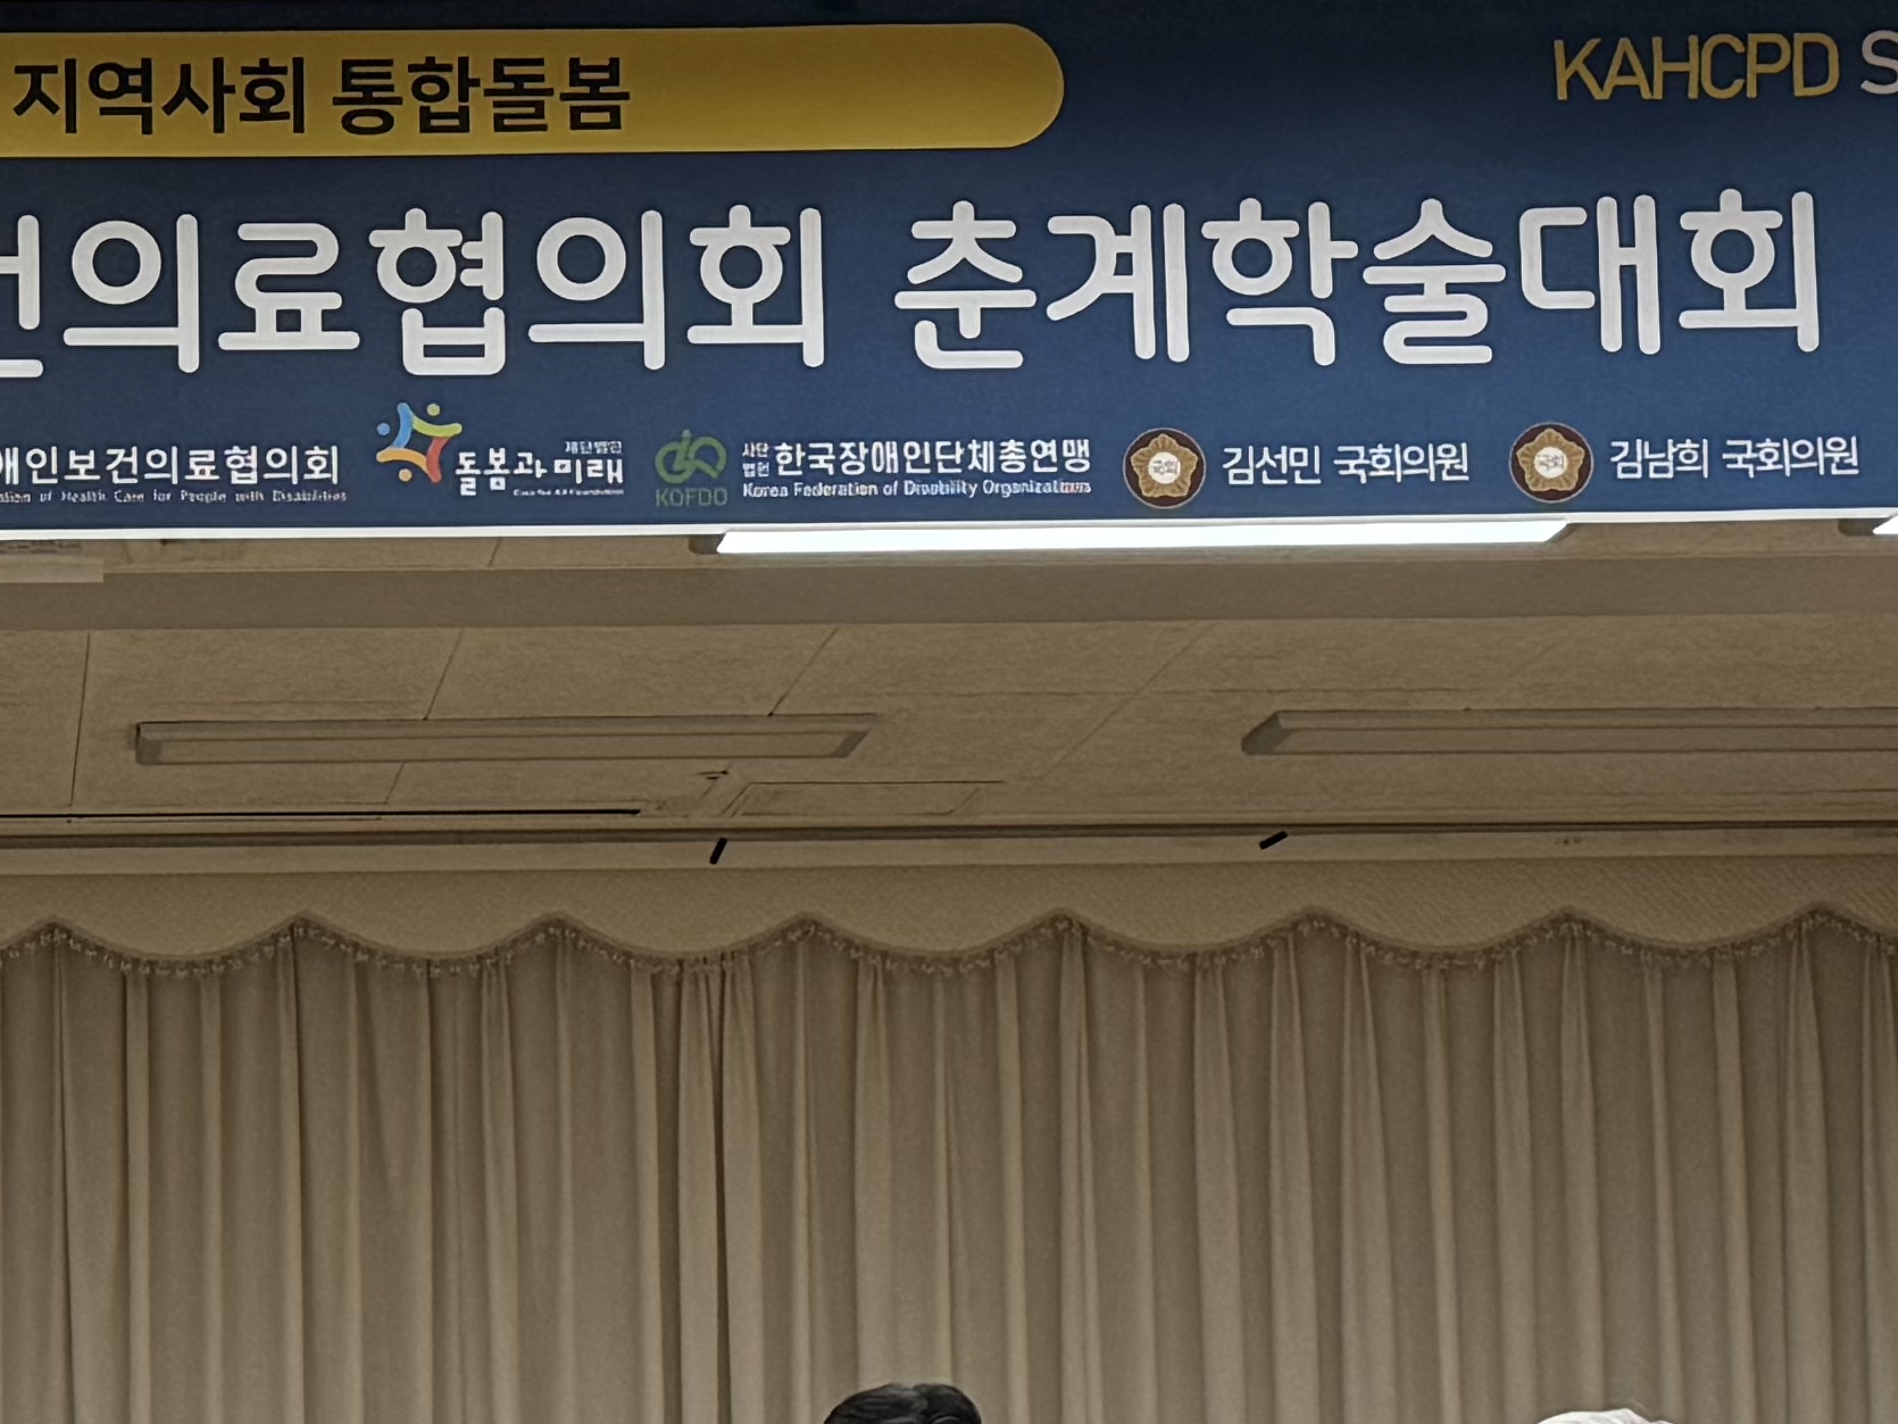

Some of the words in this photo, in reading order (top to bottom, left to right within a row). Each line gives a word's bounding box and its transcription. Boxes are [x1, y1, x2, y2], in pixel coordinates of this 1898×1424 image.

[1553, 32, 1840, 101] KAHCPD
[13, 56, 305, 136] 지역사회
[332, 55, 631, 136] 통합돌봄
[894, 188, 1820, 370] 춘계학술대회
[455, 447, 550, 496] 돌봄과
[553, 458, 624, 484] 미래
[774, 438, 1091, 476] 한국장애인단체총연맹
[1222, 445, 1322, 485] 김선민
[1333, 442, 1470, 484] 국회의원
[1610, 438, 1709, 480] 김남희
[1722, 435, 1860, 479] 국회의원
[742, 482, 789, 498] Korea
[793, 481, 879, 497] Federation
[882, 480, 899, 496] of
